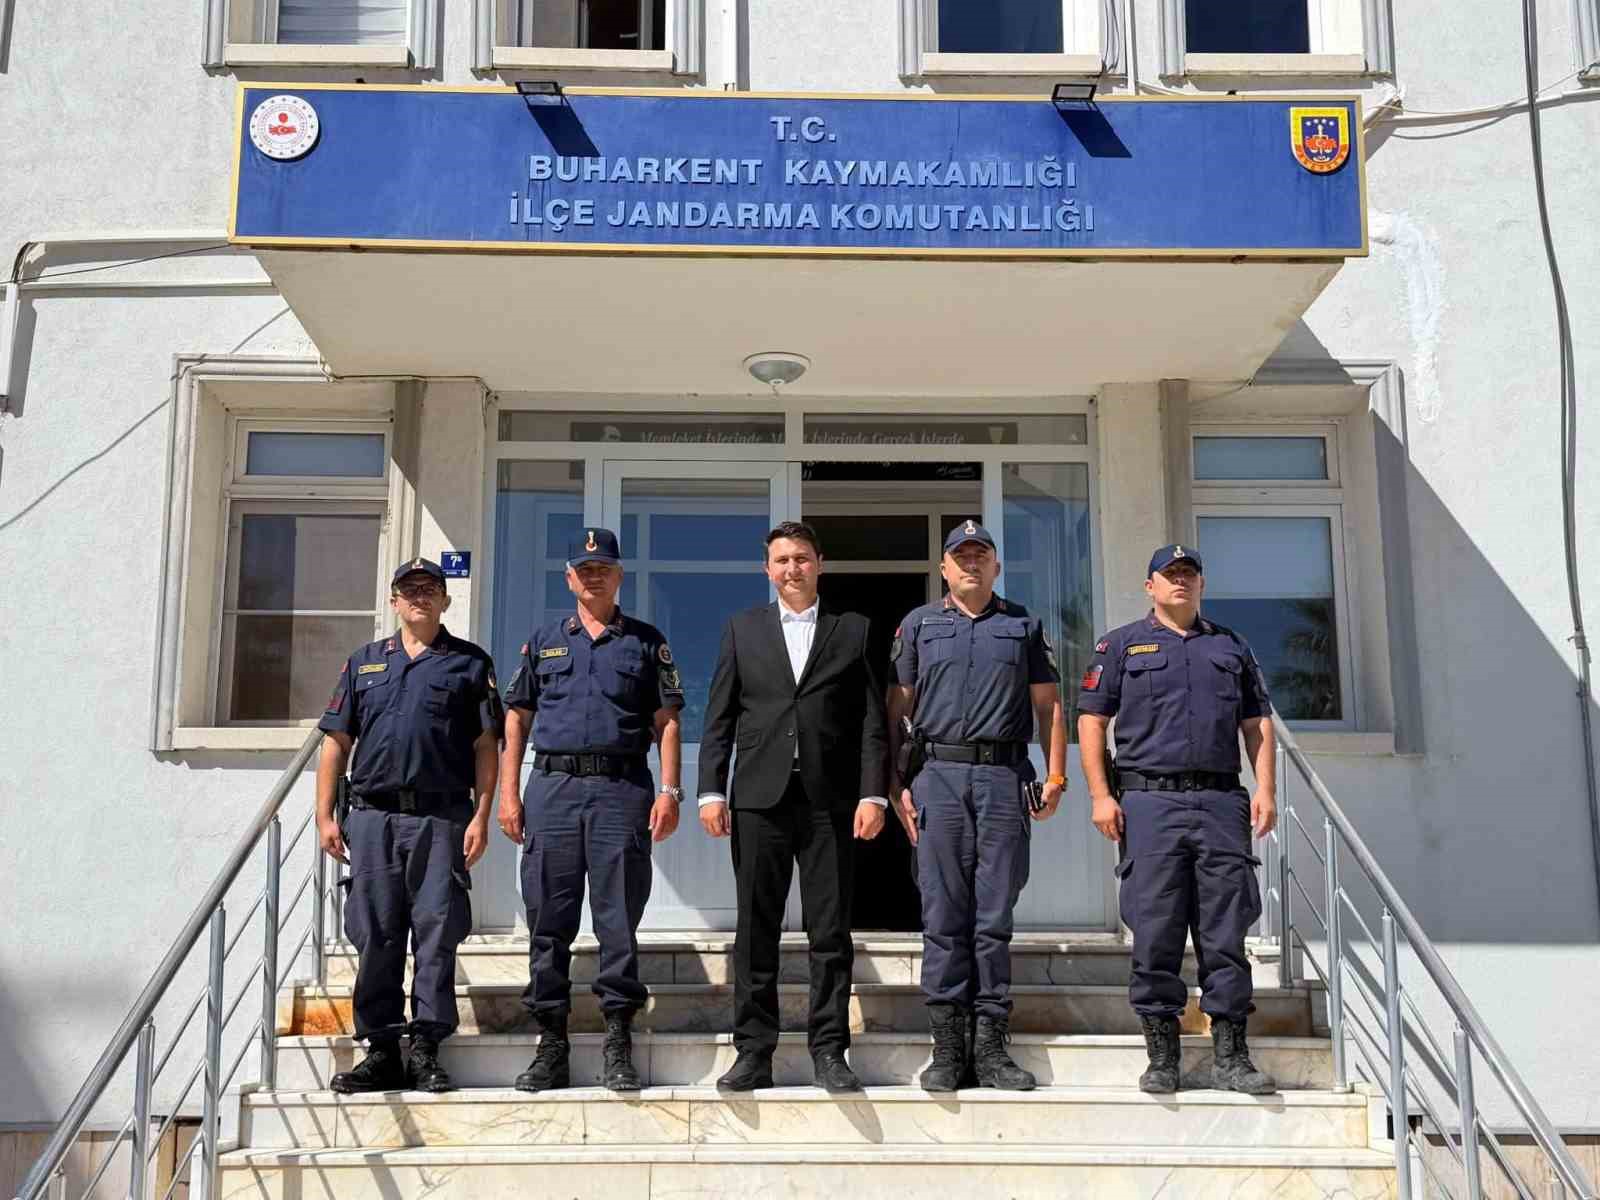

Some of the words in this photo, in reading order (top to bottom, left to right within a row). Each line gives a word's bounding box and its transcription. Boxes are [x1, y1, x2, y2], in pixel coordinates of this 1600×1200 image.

[770, 115, 837, 143] T.C.
[529, 154, 763, 185] BUHARKENT
[784, 156, 1078, 188] KAYMAKAMLIĞI
[509, 191, 596, 232] İLÇE
[606, 200, 821, 230] JANDARMA
[830, 199, 1096, 232] KOMUTANLIĞI
